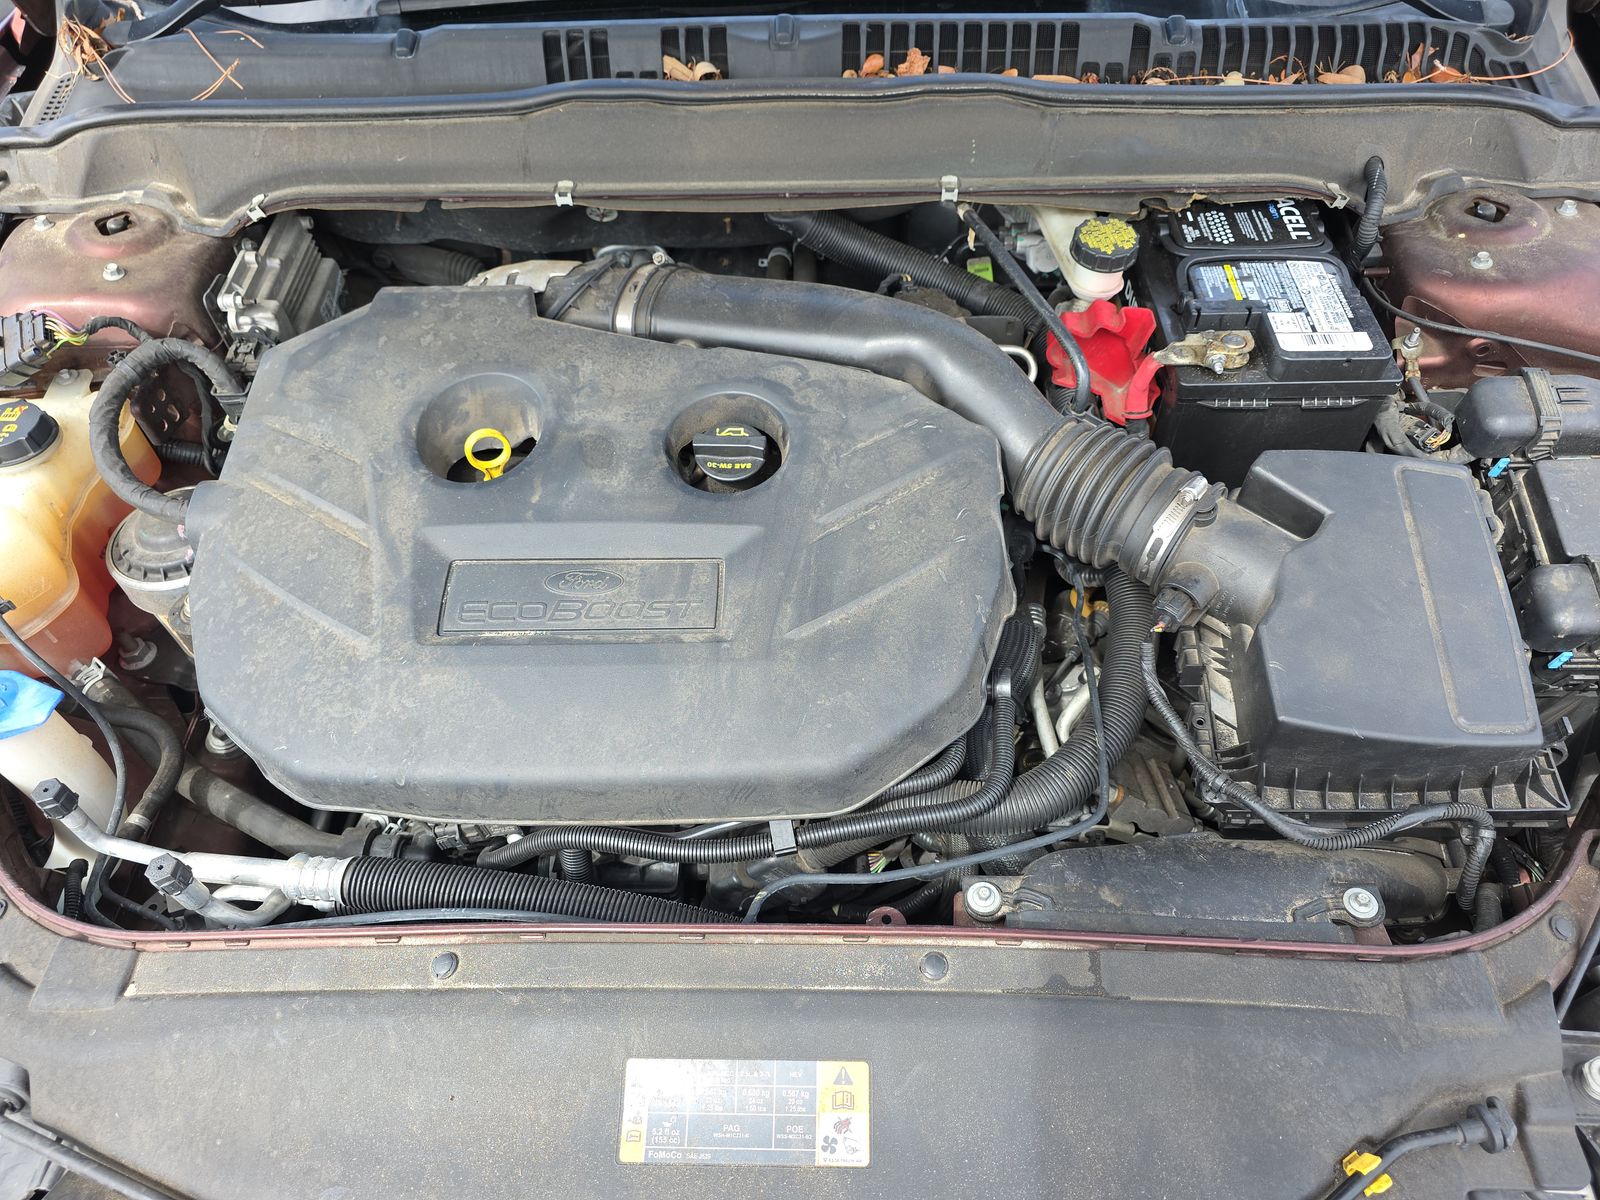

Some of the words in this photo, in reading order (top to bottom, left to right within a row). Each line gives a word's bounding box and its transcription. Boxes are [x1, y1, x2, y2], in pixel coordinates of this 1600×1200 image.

[707, 461, 733, 469] 5W-30
[557, 571, 609, 591] Ford
[800, 1090, 810, 1099] kg
[652, 1127, 663, 1135] 5.2
[723, 1124, 741, 1132] PAG
[786, 1125, 804, 1133] POE
[648, 1150, 682, 1159] FoMoCo
